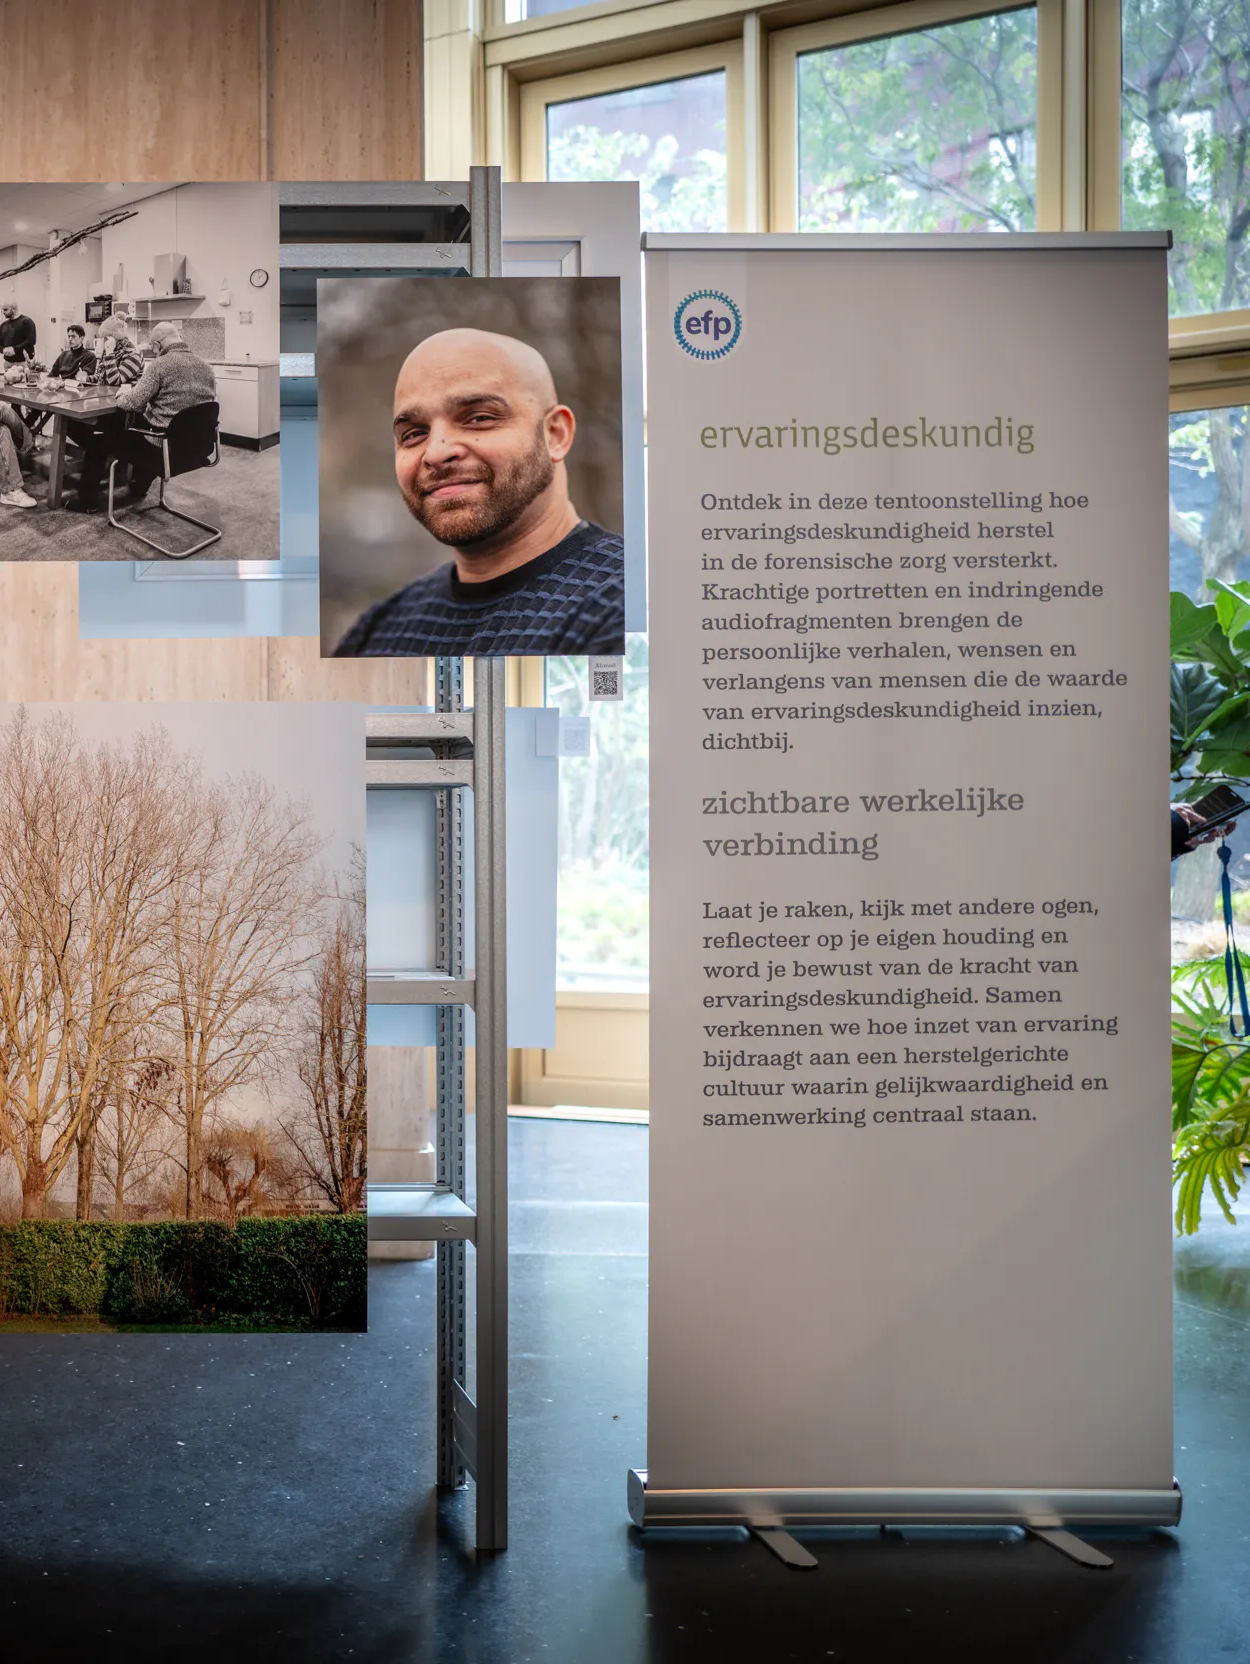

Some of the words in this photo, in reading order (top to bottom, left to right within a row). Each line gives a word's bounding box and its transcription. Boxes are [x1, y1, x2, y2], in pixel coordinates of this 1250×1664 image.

[685, 309, 732, 341] efp
[700, 416, 1035, 456] ervaringsdeskundig
[700, 492, 783, 511] Ontdek
[788, 492, 812, 510] in
[818, 492, 868, 511] deze
[873, 491, 1043, 513] tentoonstelling
[1048, 491, 1089, 509] hoe
[700, 521, 971, 545] ervaringsdeskundigheid
[977, 520, 1055, 539] herstel
[701, 552, 725, 571] in
[730, 553, 758, 571] de
[763, 552, 893, 571] forensische
[899, 553, 947, 574] zorg
[951, 550, 1058, 569] versterkt.
[701, 582, 810, 605] Krachtige
[815, 582, 929, 604] portretten
[934, 585, 962, 599] en
[967, 580, 1104, 603] indringende
[701, 612, 893, 635] audiofragmenten
[898, 611, 991, 633] brengen
[996, 610, 1023, 628] de
[701, 641, 841, 665] persoonlijke
[846, 641, 951, 661] verhalen,
[956, 644, 1044, 658] wensen
[1049, 643, 1077, 658] en
[701, 672, 826, 695] verlangens
[830, 675, 874, 690] van
[878, 674, 968, 689] mensen
[973, 669, 1008, 688] die
[1014, 669, 1041, 688] de
[1046, 668, 1128, 687] waarde
[701, 707, 745, 721] van
[750, 699, 1022, 724] ervaringsdeskundigheid
[1027, 698, 1103, 719] inzien,
[701, 731, 794, 754] dichtbij.
[702, 790, 850, 815] zichtbare
[858, 786, 1025, 818] werkelijke
[702, 830, 880, 862] verbinding
[702, 902, 753, 920] Laat
[757, 900, 779, 924] je
[784, 900, 854, 920] raken,
[859, 899, 906, 921] kijk
[910, 899, 953, 917] met
[958, 897, 1035, 916] andere
[1041, 898, 1099, 919] ogen,
[702, 931, 811, 949] reflecteer
[816, 933, 844, 952] op
[849, 929, 870, 952] je
[876, 928, 937, 951] eigen
[942, 926, 1035, 949] houding
[1041, 930, 1069, 944] en
[702, 960, 761, 979] word
[766, 960, 786, 983] je
[792, 960, 873, 978] bewust
[878, 962, 922, 976] van
[927, 957, 954, 976] de
[959, 956, 1032, 975] kracht
[1037, 960, 1079, 974] van
[702, 986, 979, 1012] ervaringsdeskundigheid.
[985, 986, 1063, 1004] Samen
[702, 1020, 824, 1038] verkennen
[829, 1022, 861, 1036] we
[866, 1017, 908, 1036] hoe
[913, 1016, 970, 1035] inzet
[974, 1020, 1018, 1034] van
[1023, 1014, 1119, 1036] ervaring
[702, 1049, 804, 1072] bijdraagt
[809, 1052, 851, 1066] aan
[856, 1051, 898, 1065] een
[903, 1044, 1069, 1068] herstelgerichte
[702, 1079, 786, 1097] cultuur
[790, 1076, 870, 1096] waarin
[874, 1073, 1075, 1099] gelijkwaardigheid
[1080, 1077, 1109, 1091] en
[702, 1106, 867, 1129] samenwerking
[872, 1104, 965, 1124] centraal
[970, 1106, 1037, 1122] staan.
